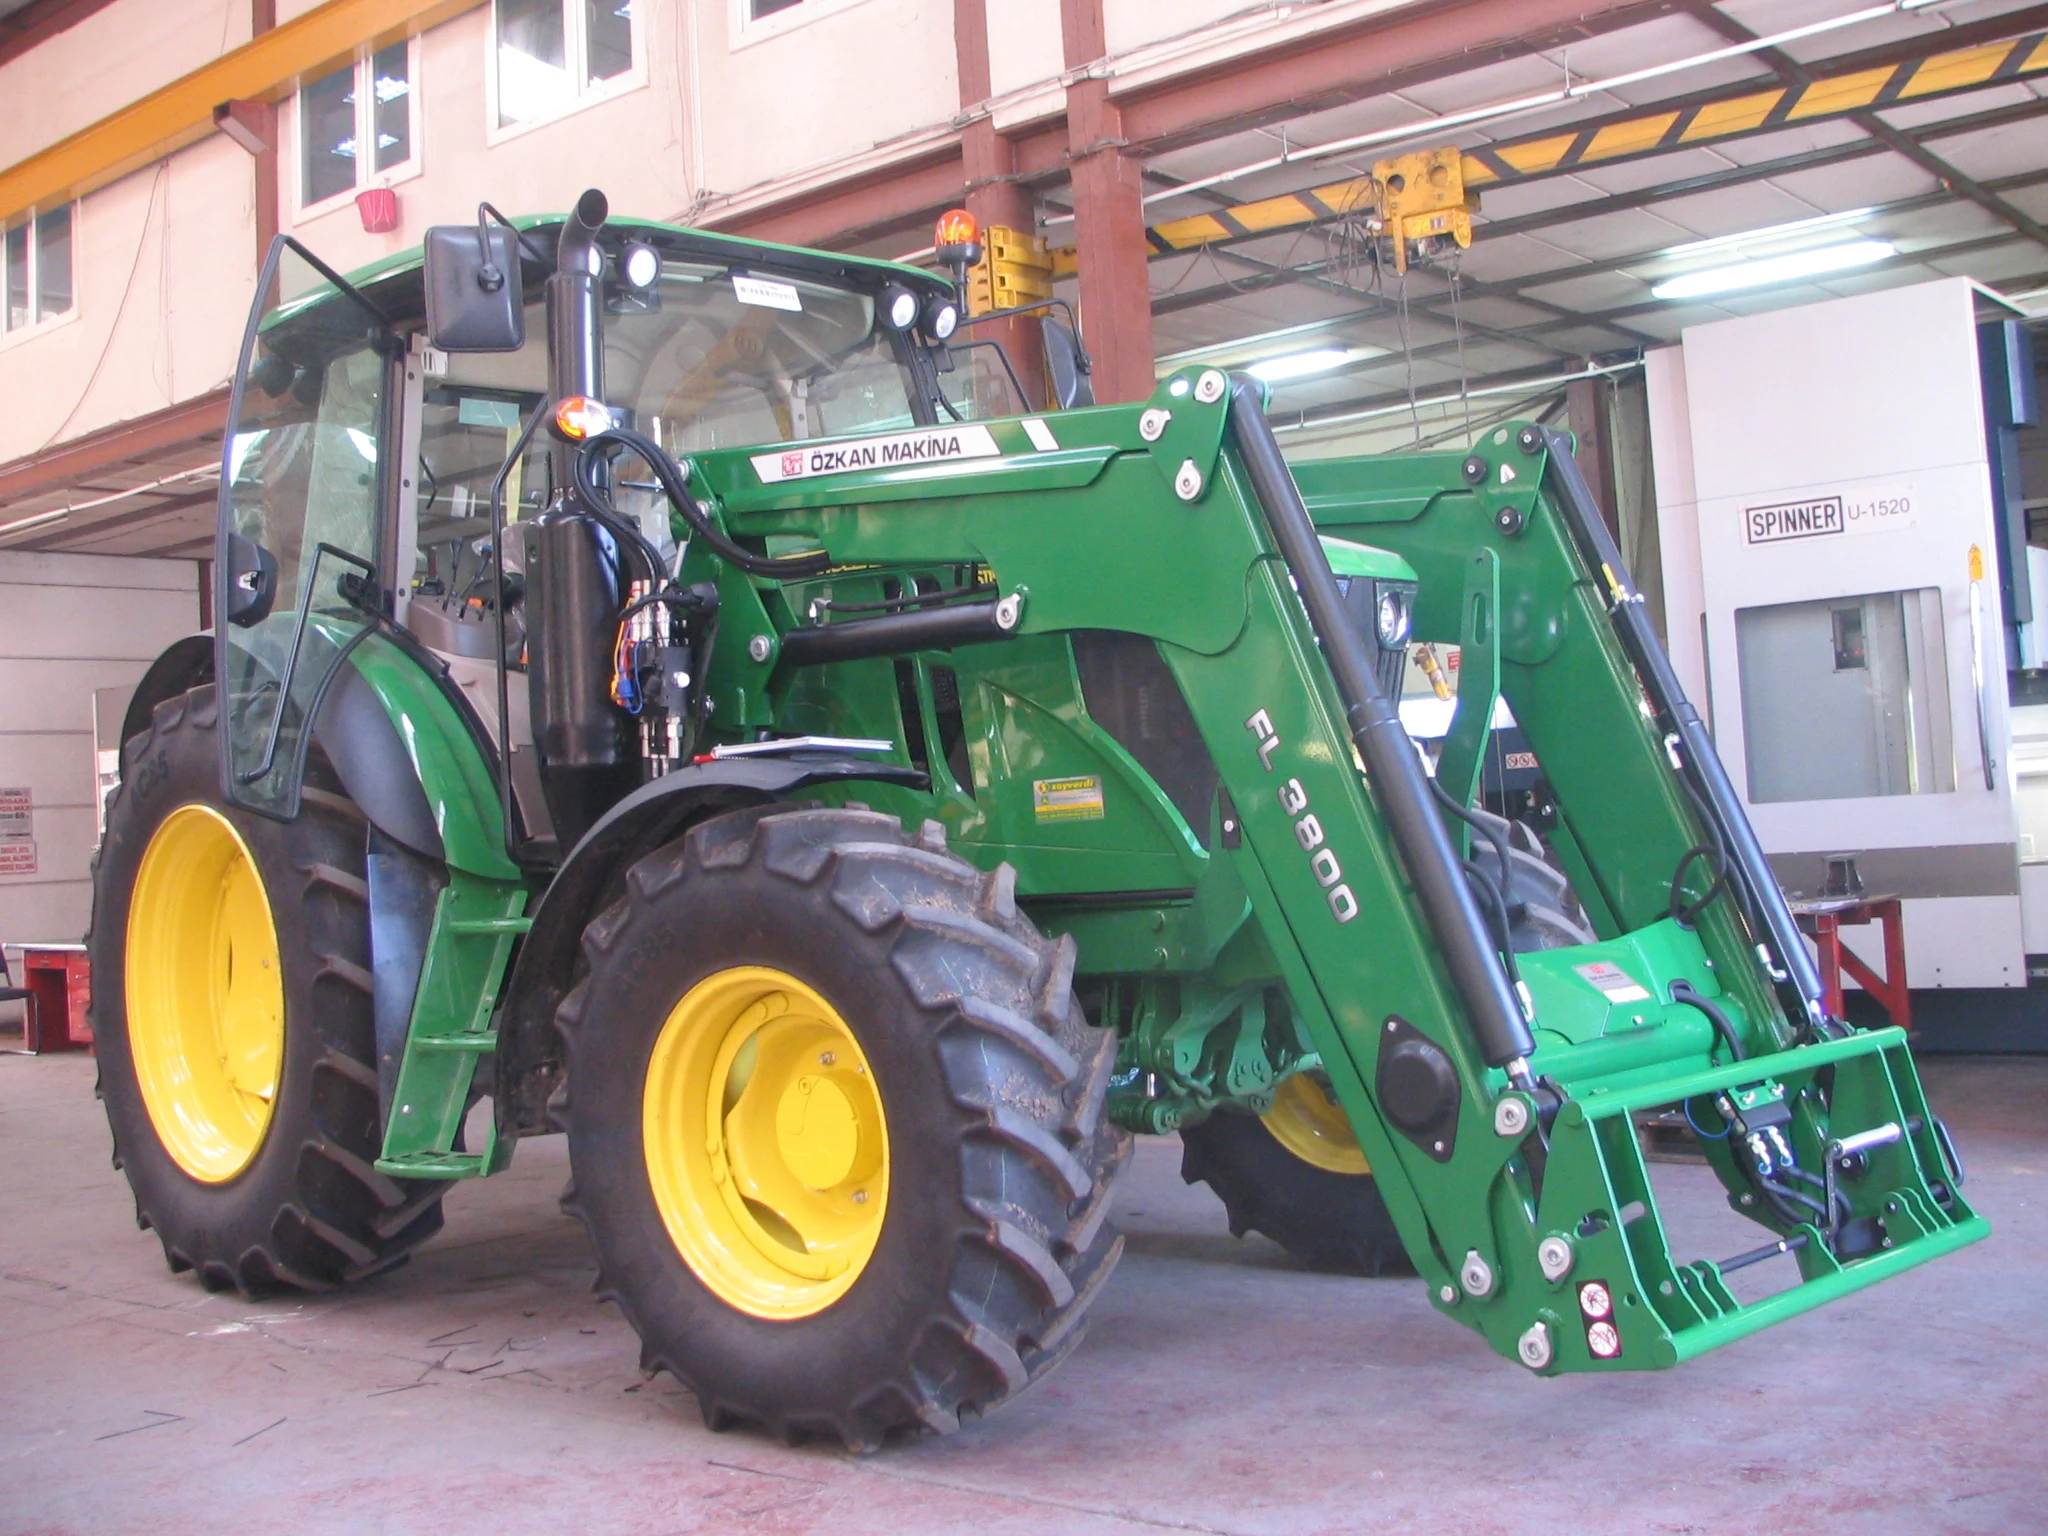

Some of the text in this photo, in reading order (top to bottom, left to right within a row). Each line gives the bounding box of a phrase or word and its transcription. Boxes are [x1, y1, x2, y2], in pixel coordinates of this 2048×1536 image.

[811, 434, 962, 472] ÖZKAN MAKİNA
[1752, 497, 1911, 537] SPINNER U-1520
[1244, 708, 1360, 924] FL 3800
